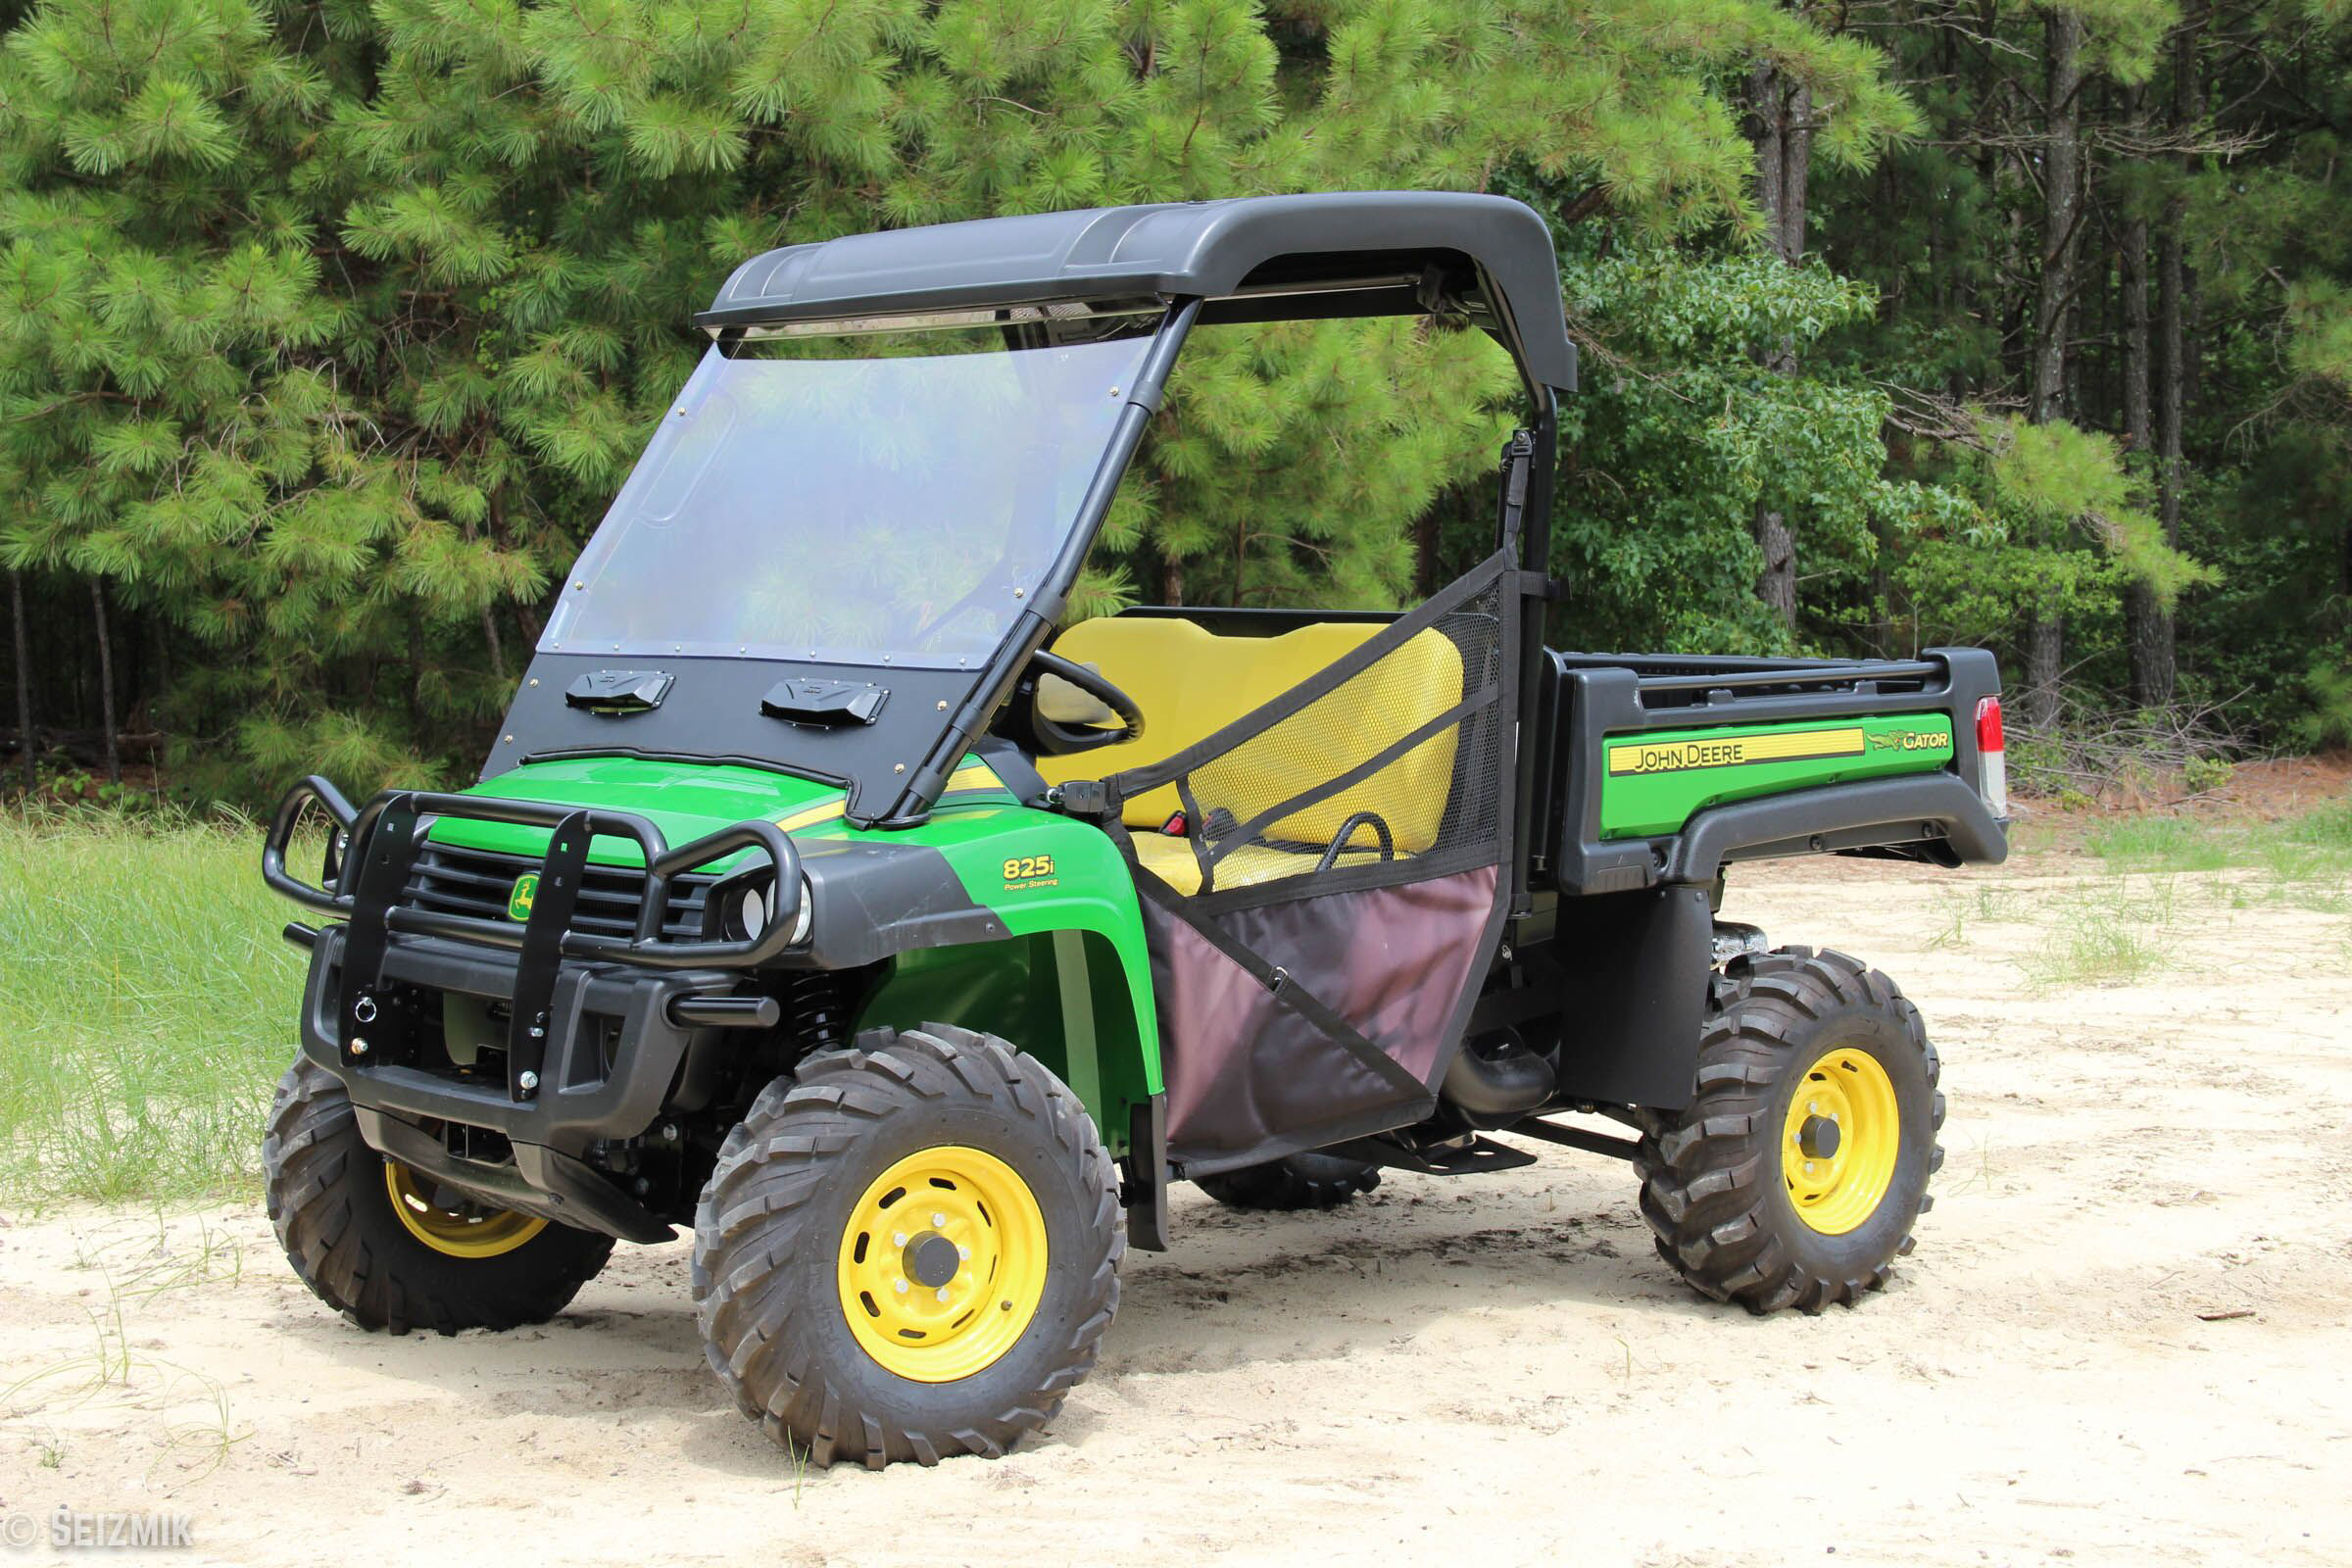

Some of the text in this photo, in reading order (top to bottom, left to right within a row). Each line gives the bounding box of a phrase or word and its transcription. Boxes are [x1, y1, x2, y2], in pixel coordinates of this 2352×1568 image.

[1903, 732, 1948, 751] GATOR
[1636, 745, 1743, 769] JOHN DEERE
[1003, 855, 1054, 880] 825i
[1028, 878, 1058, 888] Steering
